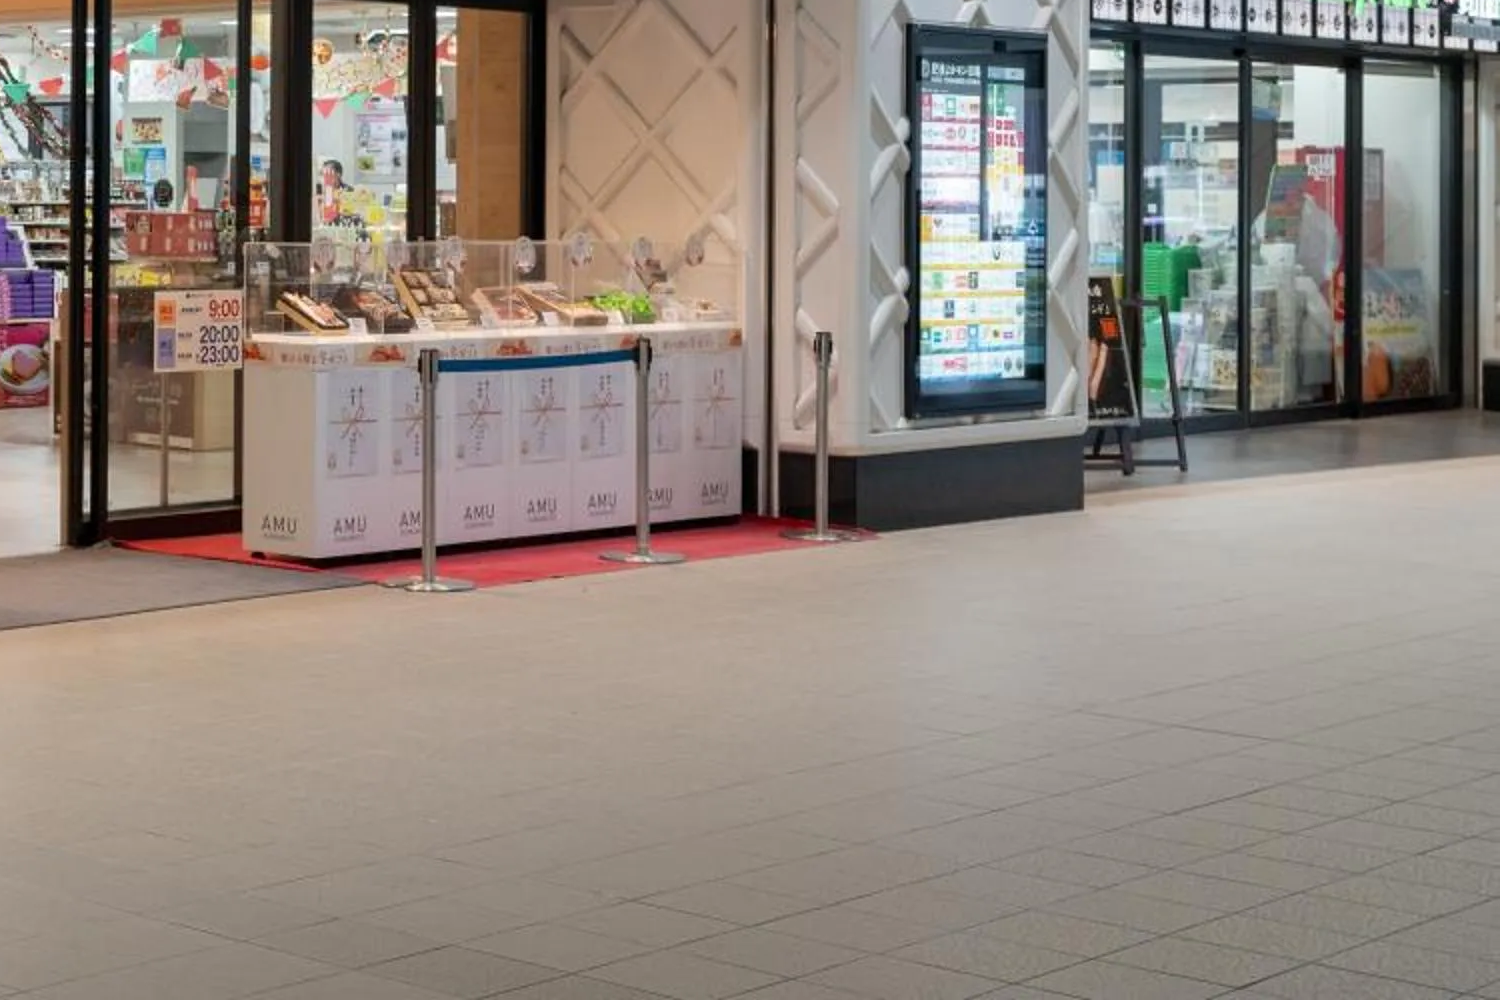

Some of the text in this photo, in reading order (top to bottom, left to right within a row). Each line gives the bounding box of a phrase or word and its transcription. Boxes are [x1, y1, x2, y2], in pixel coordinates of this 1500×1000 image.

[209, 299, 240, 317] 9:00
[200, 325, 239, 344] 20:00
[200, 345, 239, 364] 23:00
[701, 482, 729, 498] AMU
[527, 499, 557, 515] AMU
[587, 494, 617, 510] AMU
[400, 511, 421, 528] AM
[463, 504, 495, 521] AMU
[261, 515, 297, 535] AMU
[333, 516, 367, 535] AMU
